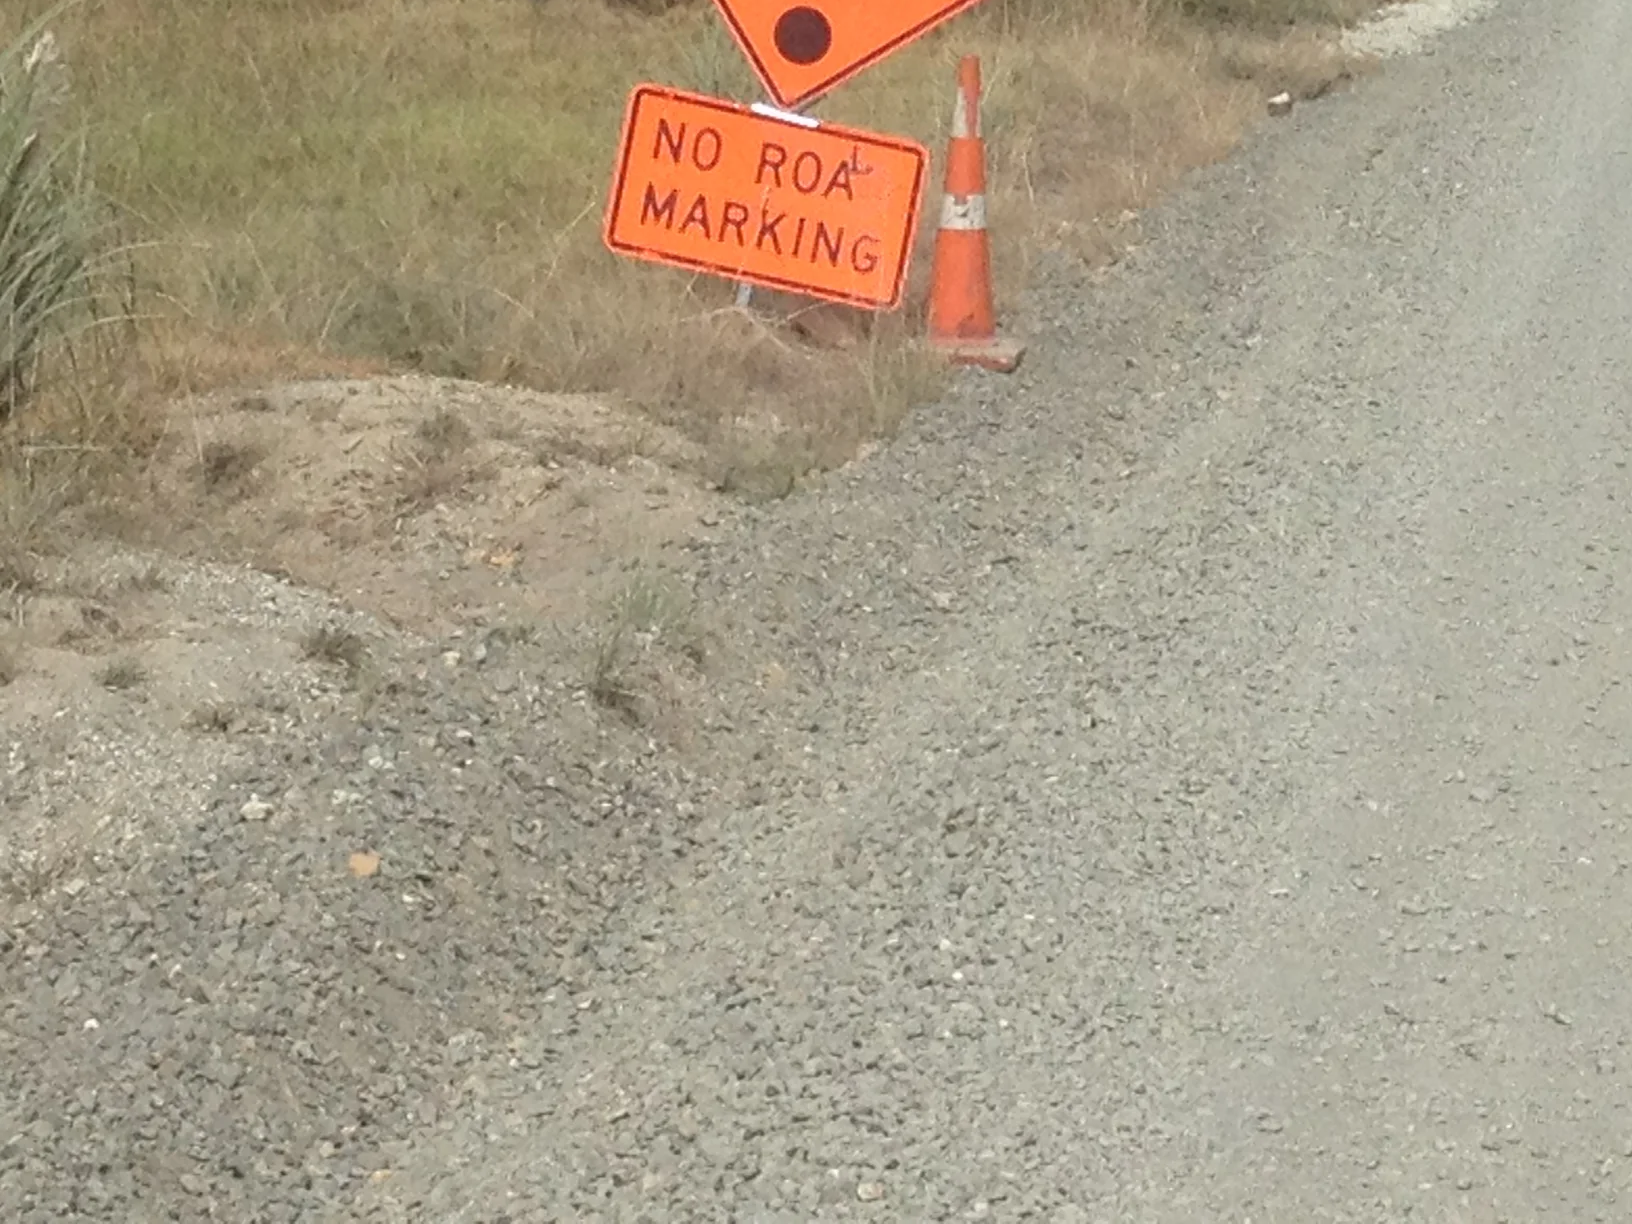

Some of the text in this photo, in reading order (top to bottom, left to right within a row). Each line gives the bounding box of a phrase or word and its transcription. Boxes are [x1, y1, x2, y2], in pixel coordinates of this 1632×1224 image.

[653, 118, 872, 200] NO ROA
[640, 181, 880, 274] MARKING
